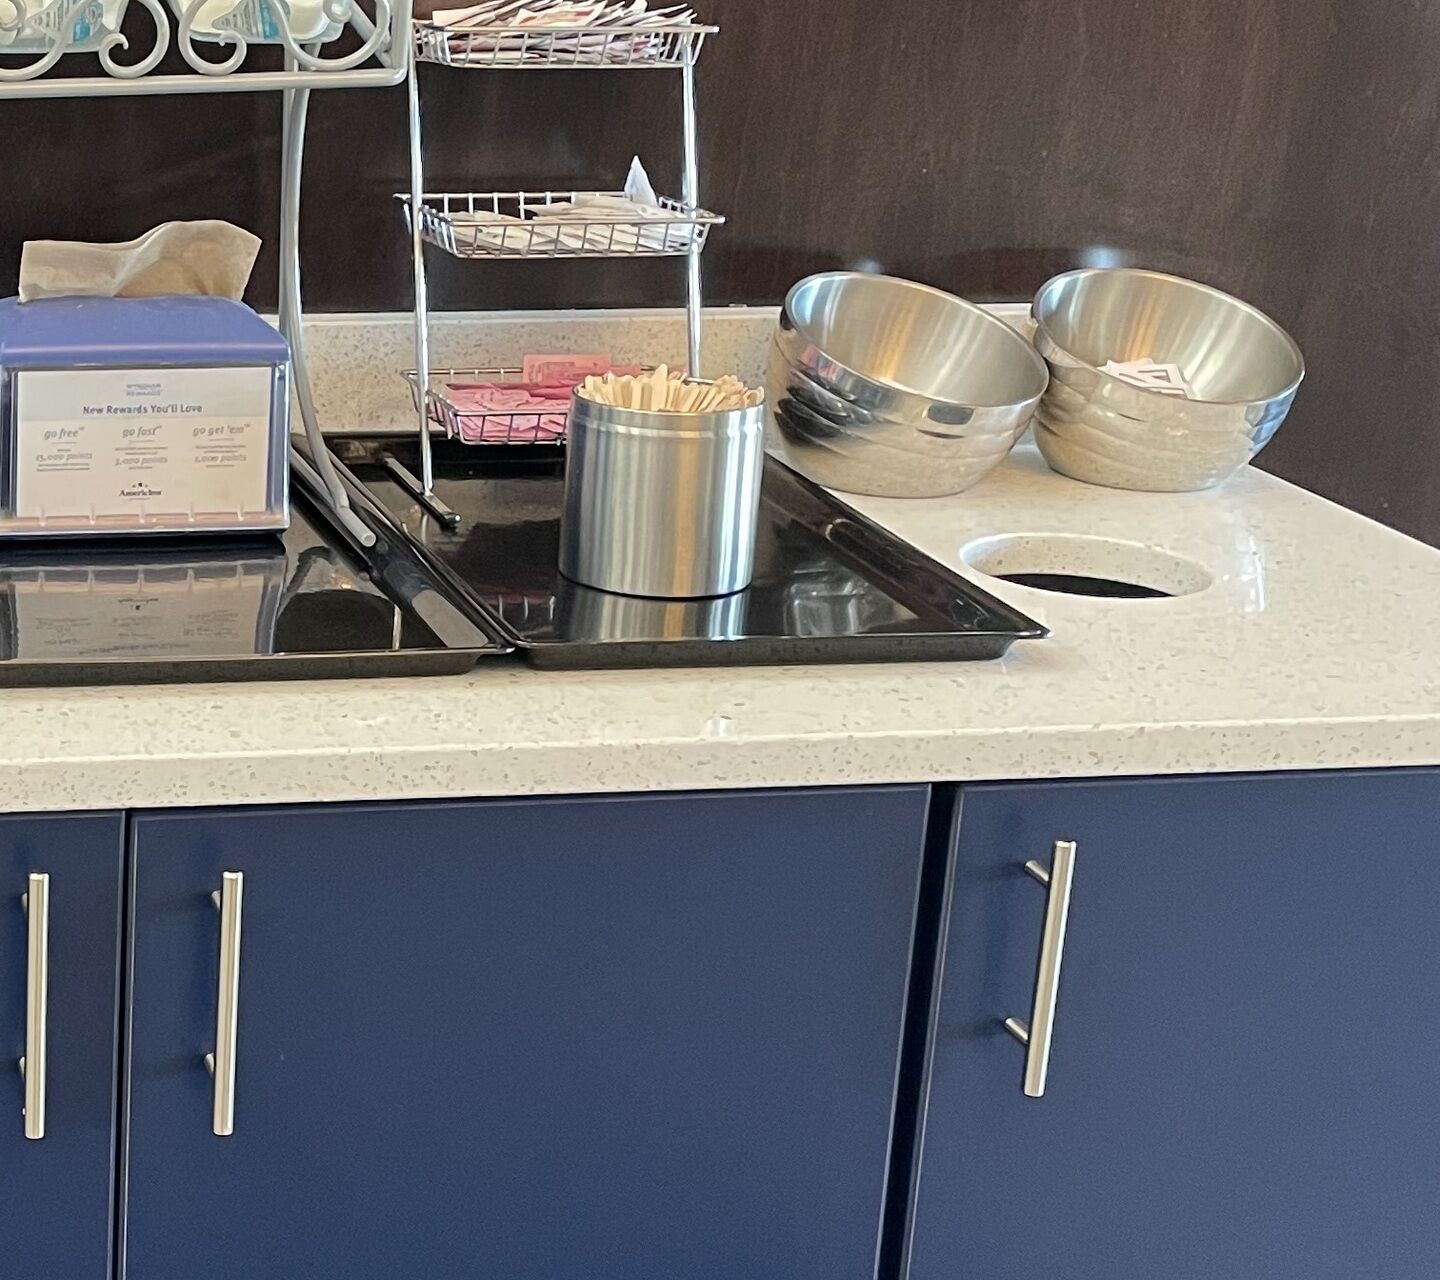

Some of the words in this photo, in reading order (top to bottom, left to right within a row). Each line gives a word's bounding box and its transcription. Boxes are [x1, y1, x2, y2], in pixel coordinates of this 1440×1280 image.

[82, 405, 104, 415] New
[106, 404, 149, 415] Rewards
[150, 403, 179, 413] You'll
[180, 403, 203, 413] Love
[44, 429, 58, 440] go
[122, 428, 136, 438] go
[193, 427, 206, 437] go
[207, 426, 225, 437] get
